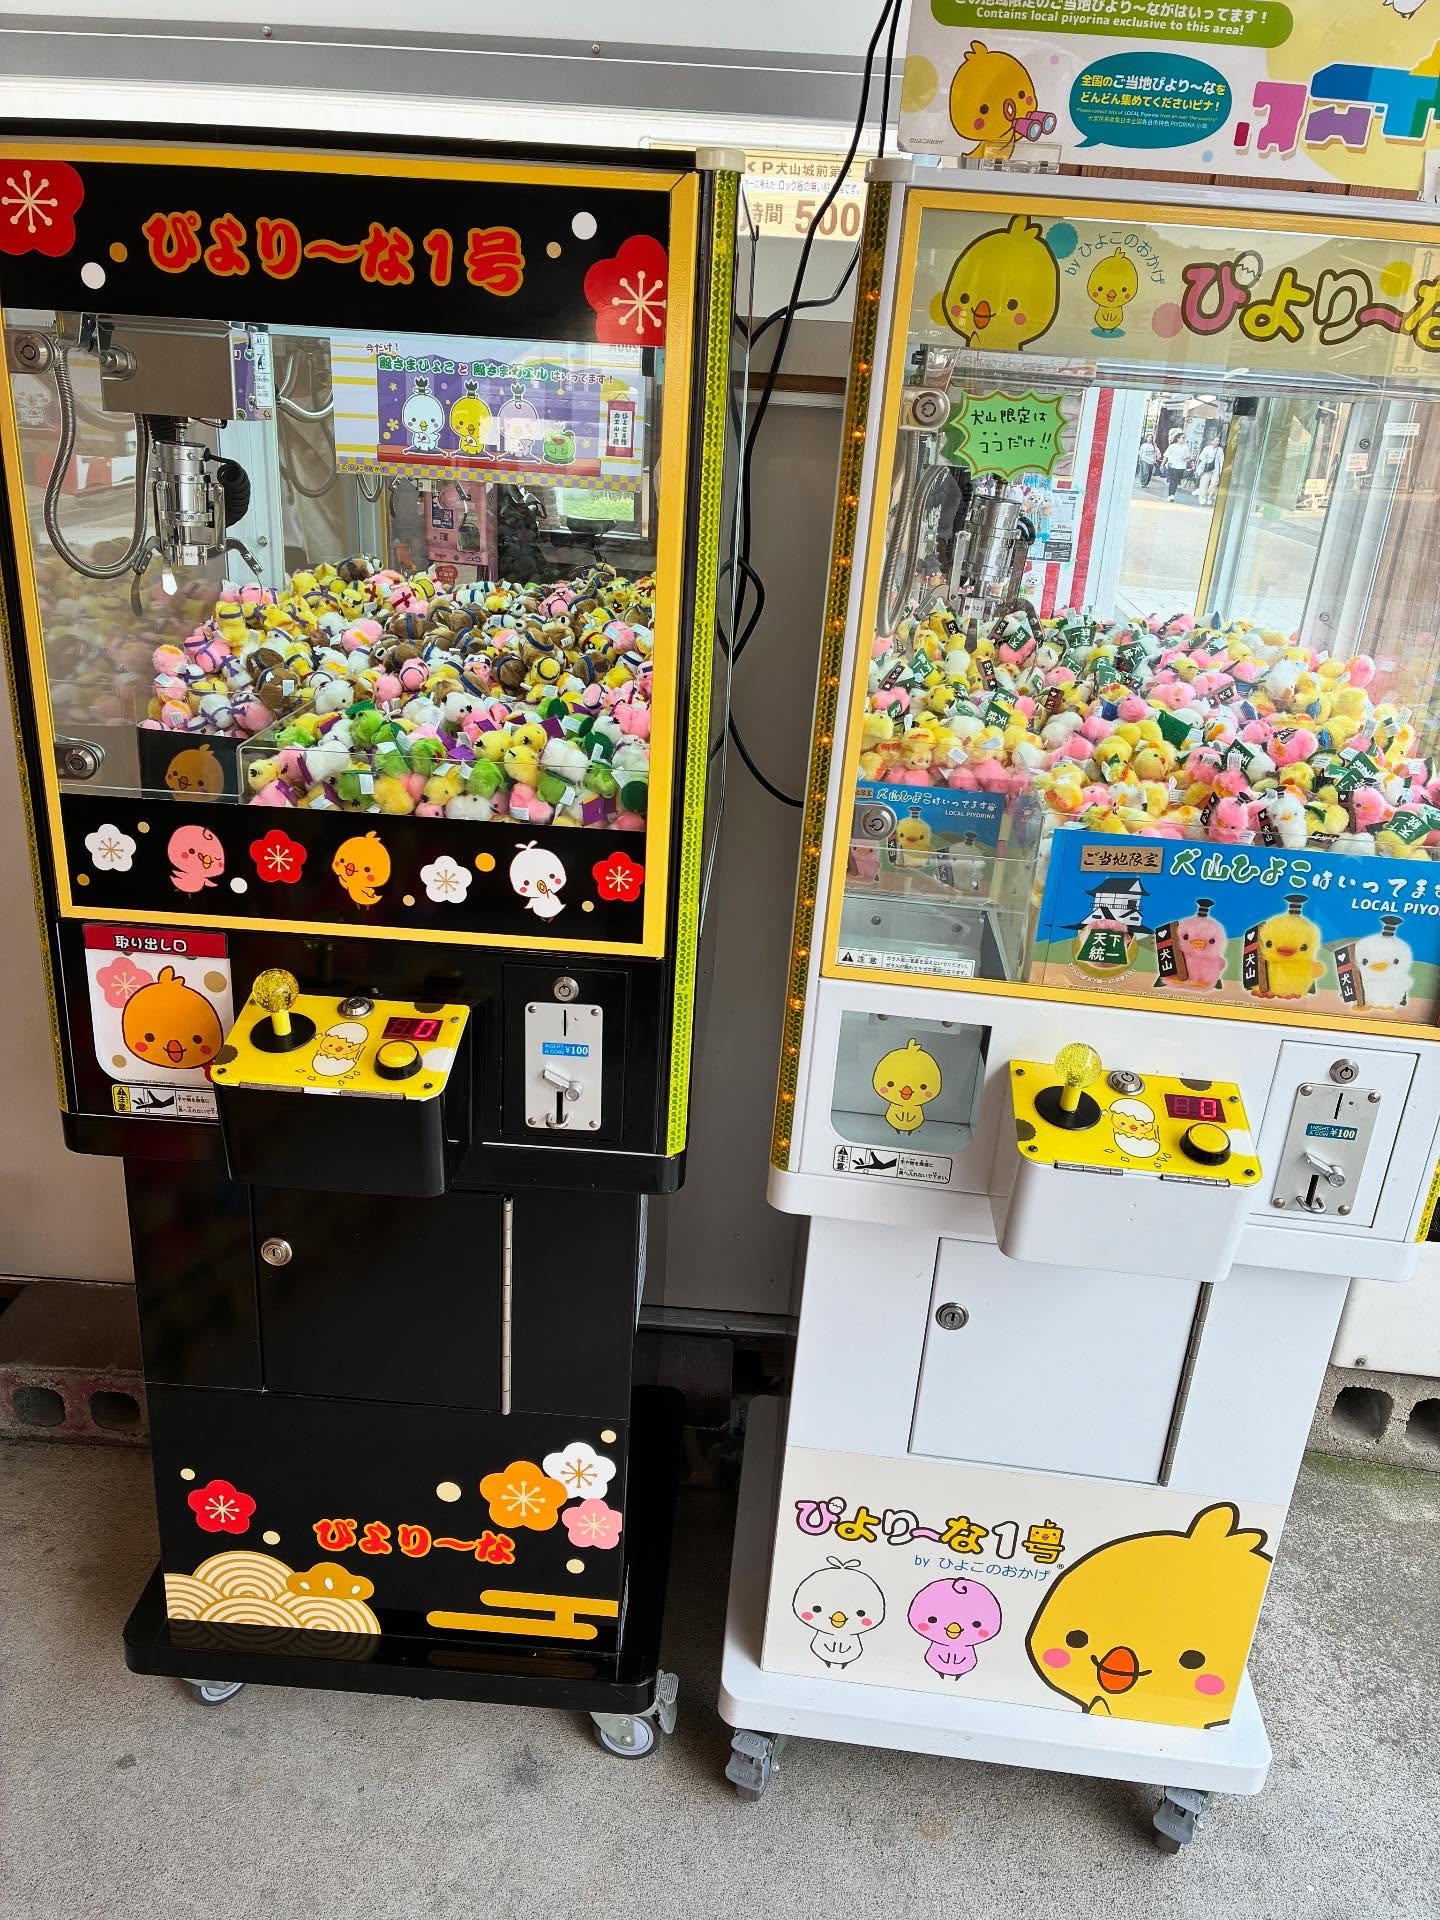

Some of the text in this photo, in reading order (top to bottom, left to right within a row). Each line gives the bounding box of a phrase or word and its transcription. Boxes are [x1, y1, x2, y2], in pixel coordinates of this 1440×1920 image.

[976, 7, 1245, 36] Contains local piyorina exclusive to this area!
[1081, 74, 1227, 96] 全国のご当地ぴより〜なを
[795, 199, 861, 237] 500
[142, 211, 526, 297] ぴより〜な1号
[1066, 231, 1166, 285] by ひよこのおかげ
[366, 342, 400, 353] 今だけ！
[970, 406, 1048, 426] 犬山限定は
[945, 810, 995, 820] LOCAL PIYORINA
[1083, 847, 1160, 869] ご当地限定
[1351, 898, 1440, 916] LOCAL PIYO
[114, 935, 187, 952] 取り出し口
[1092, 932, 1122, 948] 天下
[1088, 946, 1120, 961] 統一
[1159, 948, 1173, 971] 犬山
[1244, 953, 1257, 980] 犬山
[1341, 972, 1354, 998] 犬山
[565, 1045, 589, 1055] ¥100
[1330, 1127, 1356, 1139] ¥100
[795, 1496, 1066, 1564] ぴより〜な1号
[313, 1518, 516, 1565] ぴより〜な
[914, 1554, 1051, 1582] by ひよこのおかげ
